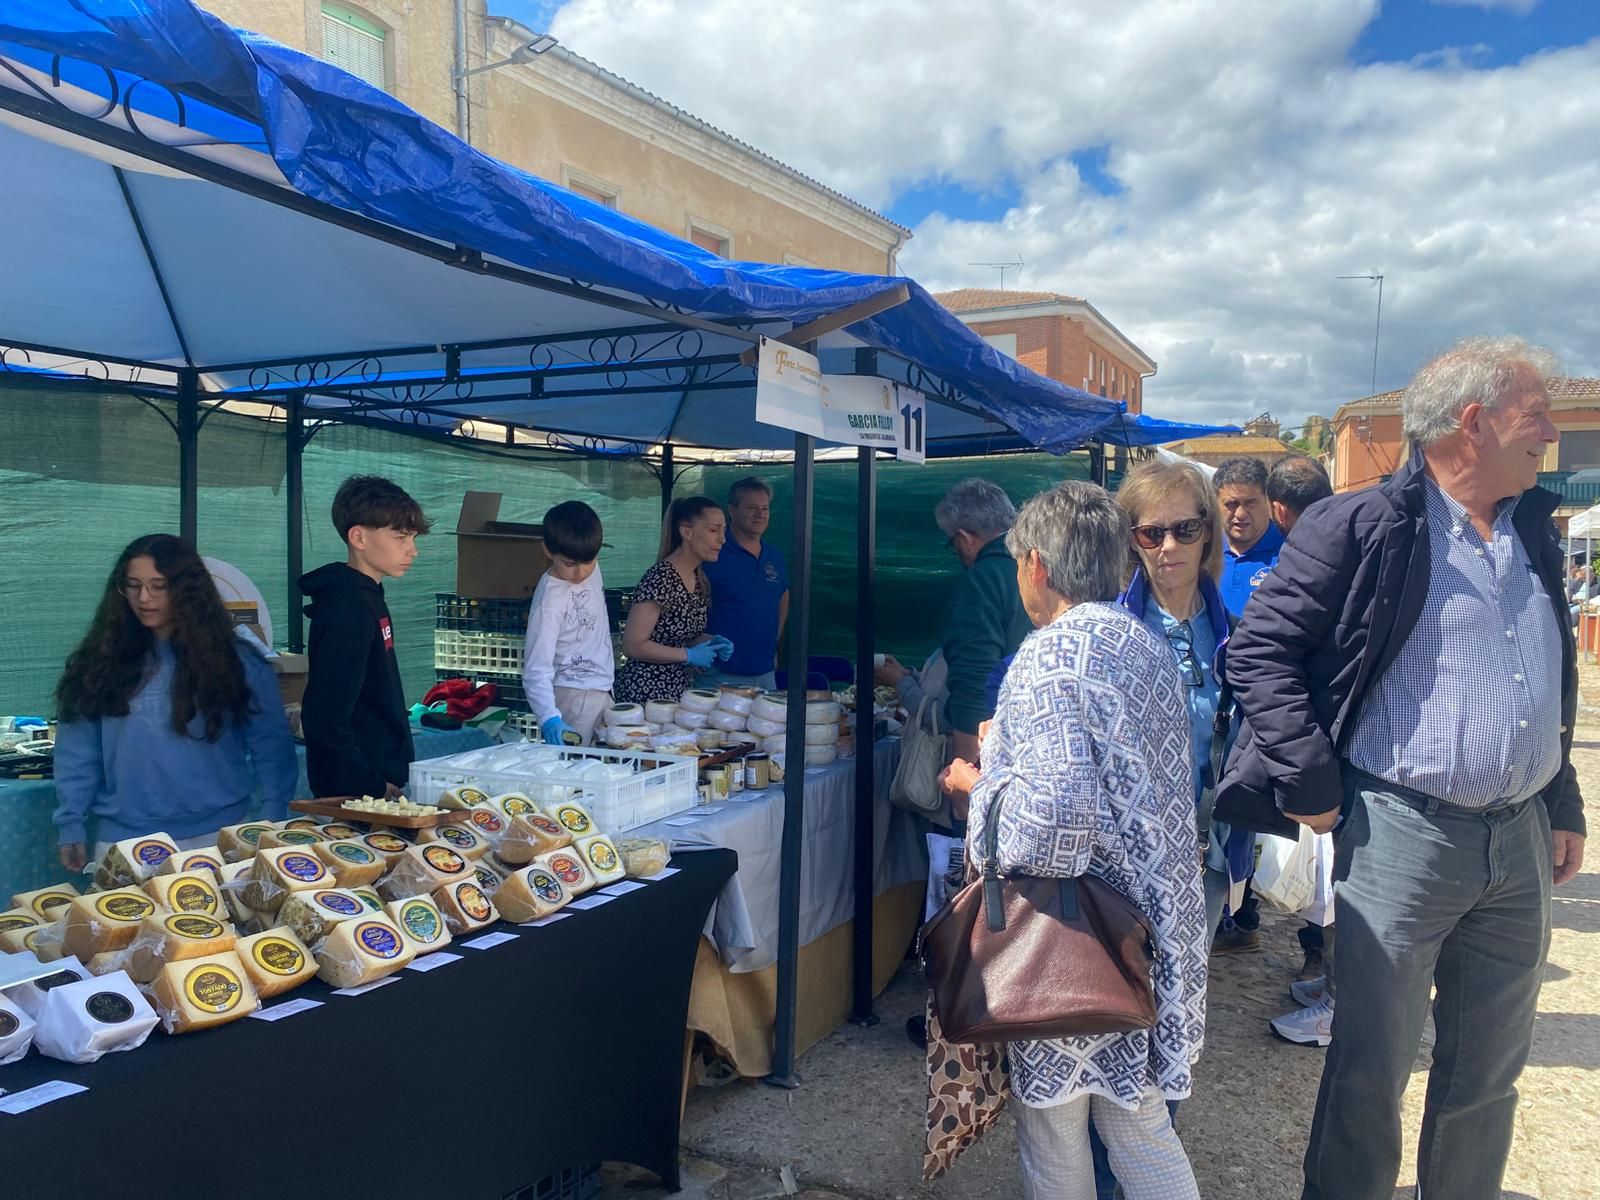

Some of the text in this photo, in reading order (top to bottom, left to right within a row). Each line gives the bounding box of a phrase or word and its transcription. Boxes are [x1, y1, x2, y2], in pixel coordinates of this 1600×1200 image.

[848, 414, 877, 429] GARCIA
[901, 404, 922, 453] 11
[200, 983, 227, 995] TOSTADO
